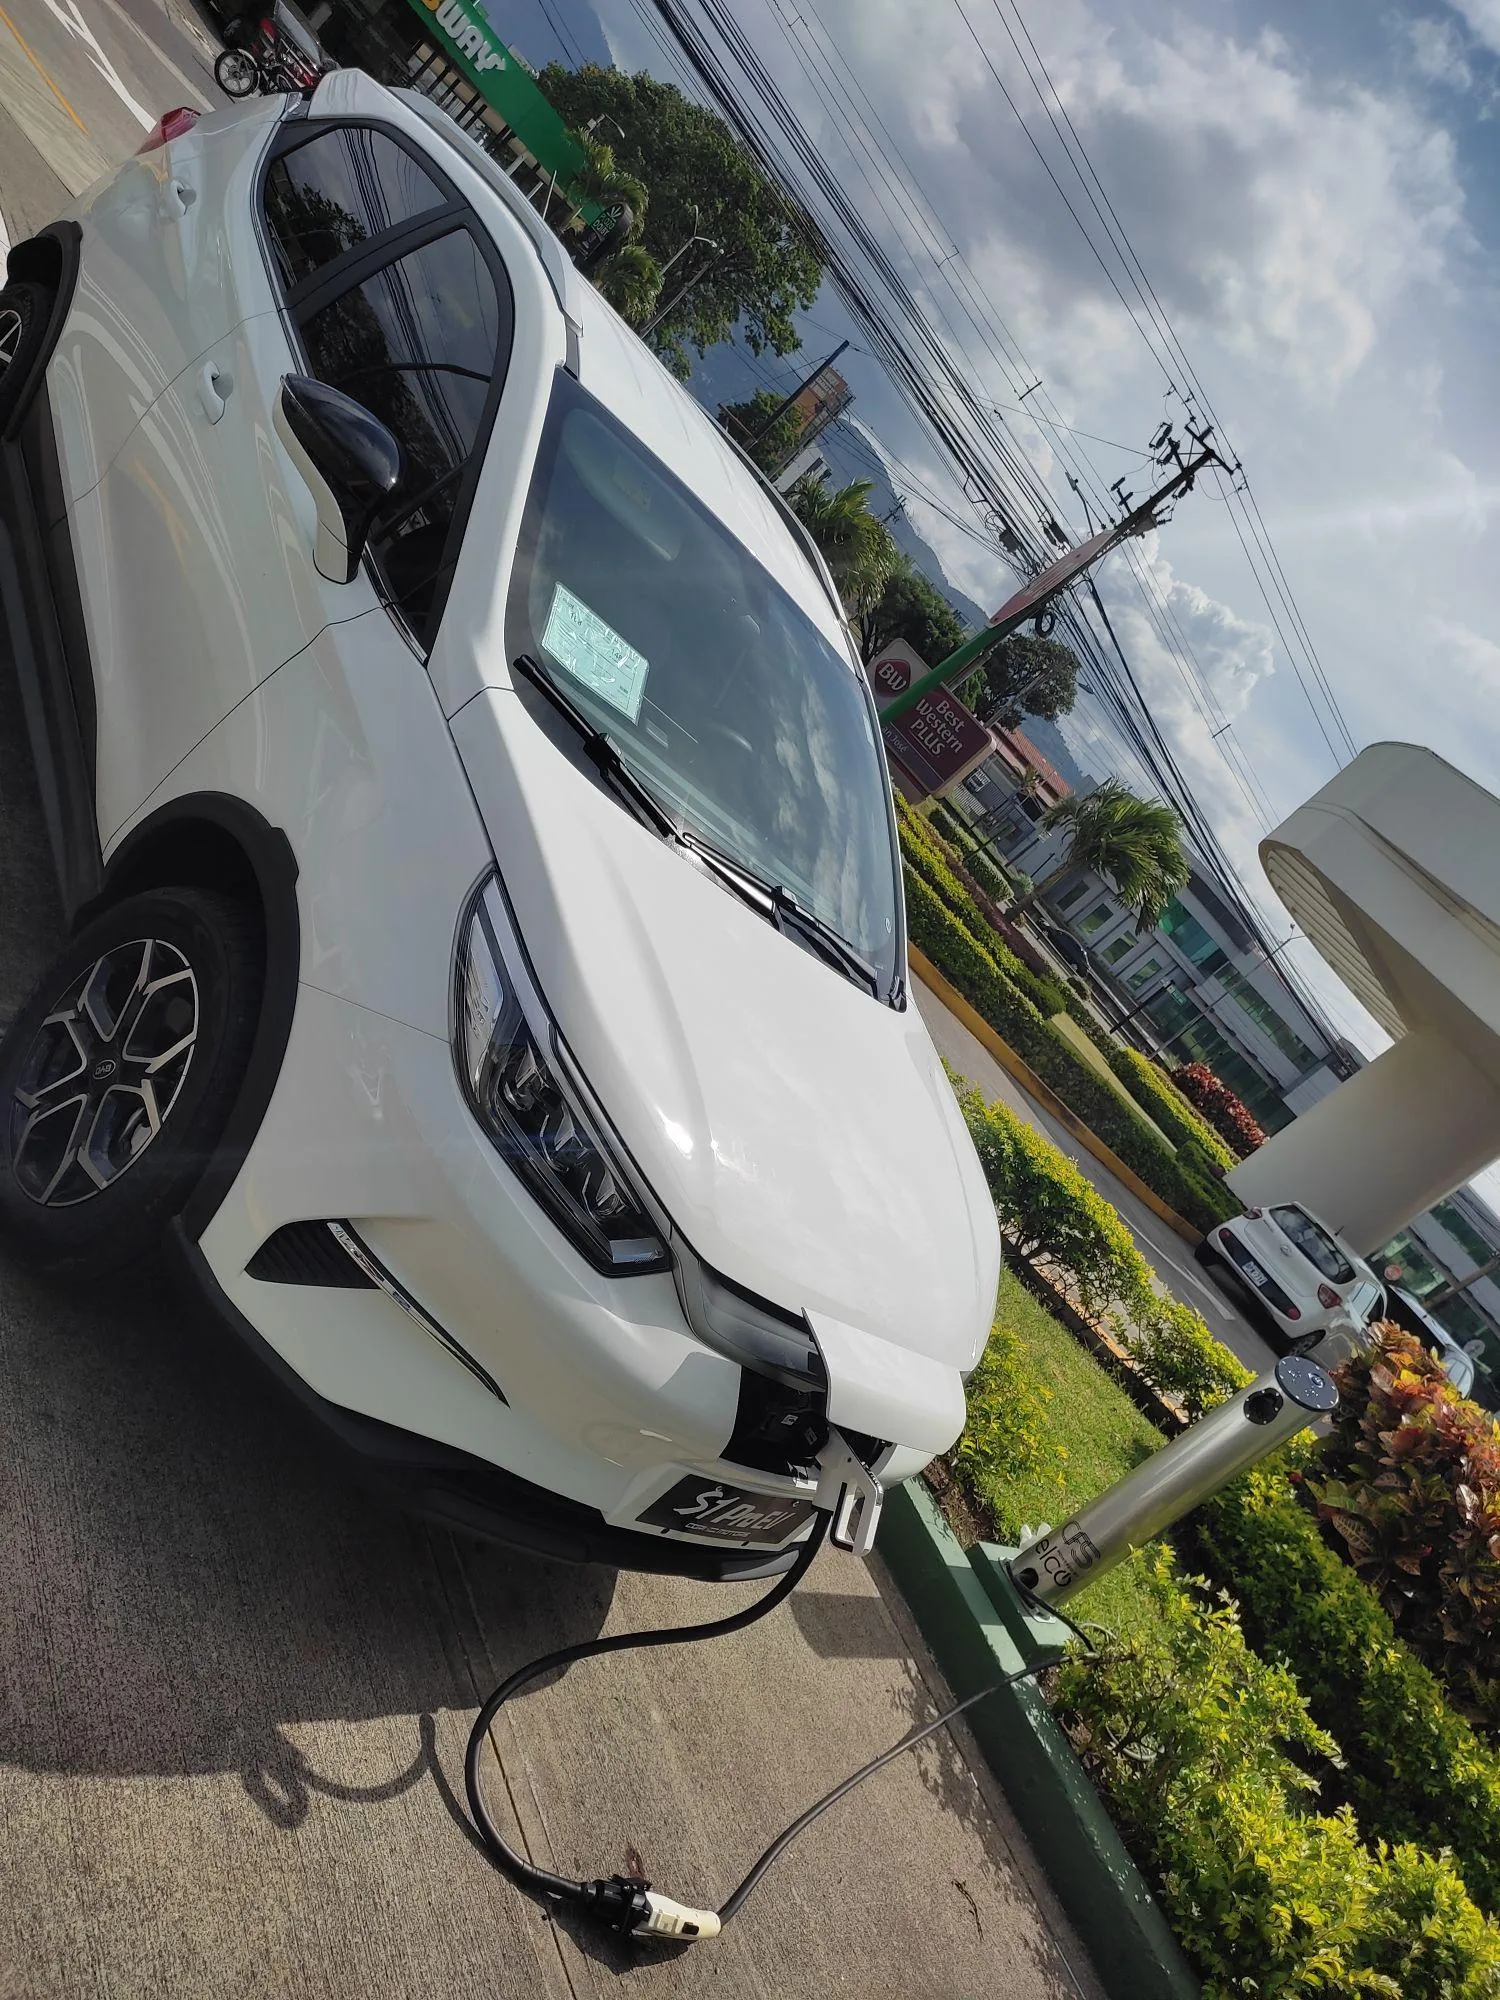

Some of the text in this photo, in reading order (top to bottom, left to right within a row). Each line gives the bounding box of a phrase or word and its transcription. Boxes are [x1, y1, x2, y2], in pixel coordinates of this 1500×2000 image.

[422, 0, 506, 72] WAY
[878, 662, 907, 691] BW
[916, 698, 963, 753] Western
[935, 700, 965, 733] Best
[910, 718, 946, 755] PLUS
